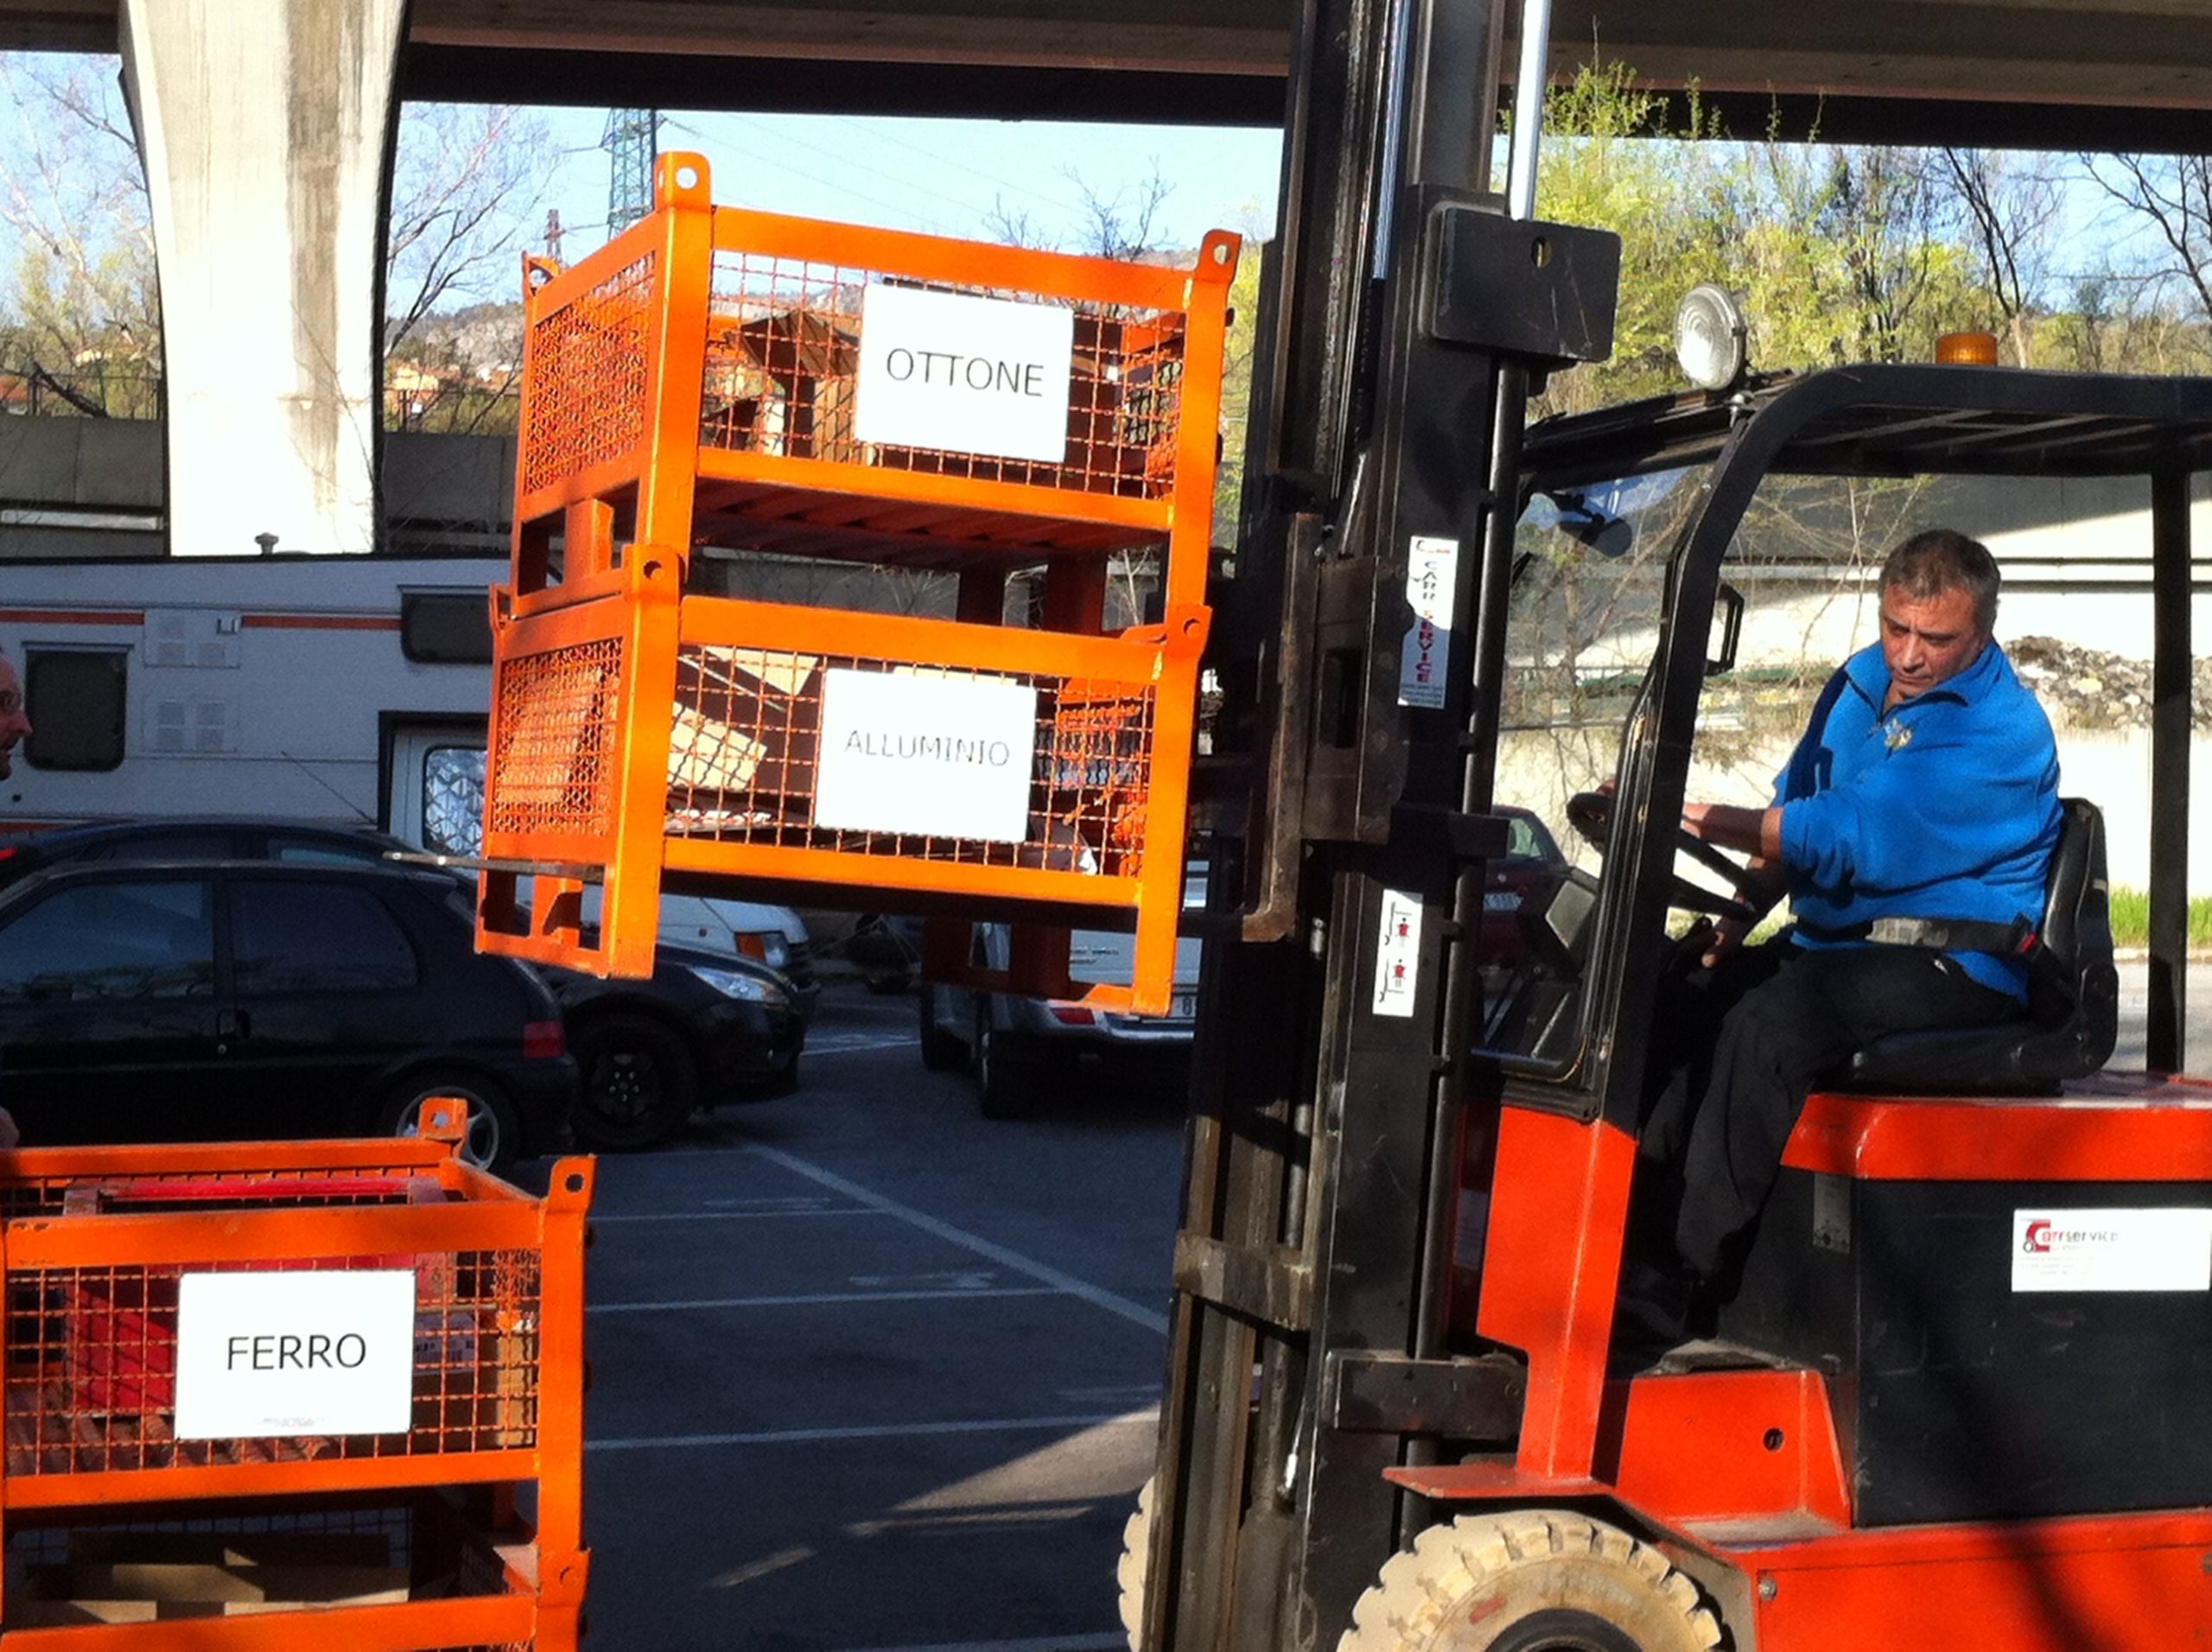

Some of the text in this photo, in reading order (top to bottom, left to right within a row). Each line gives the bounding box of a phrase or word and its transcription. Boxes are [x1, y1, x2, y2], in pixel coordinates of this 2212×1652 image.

[887, 348, 1044, 397] OTTONE
[844, 730, 1009, 766] ALLUMINIO
[227, 1333, 366, 1370] FERRO
